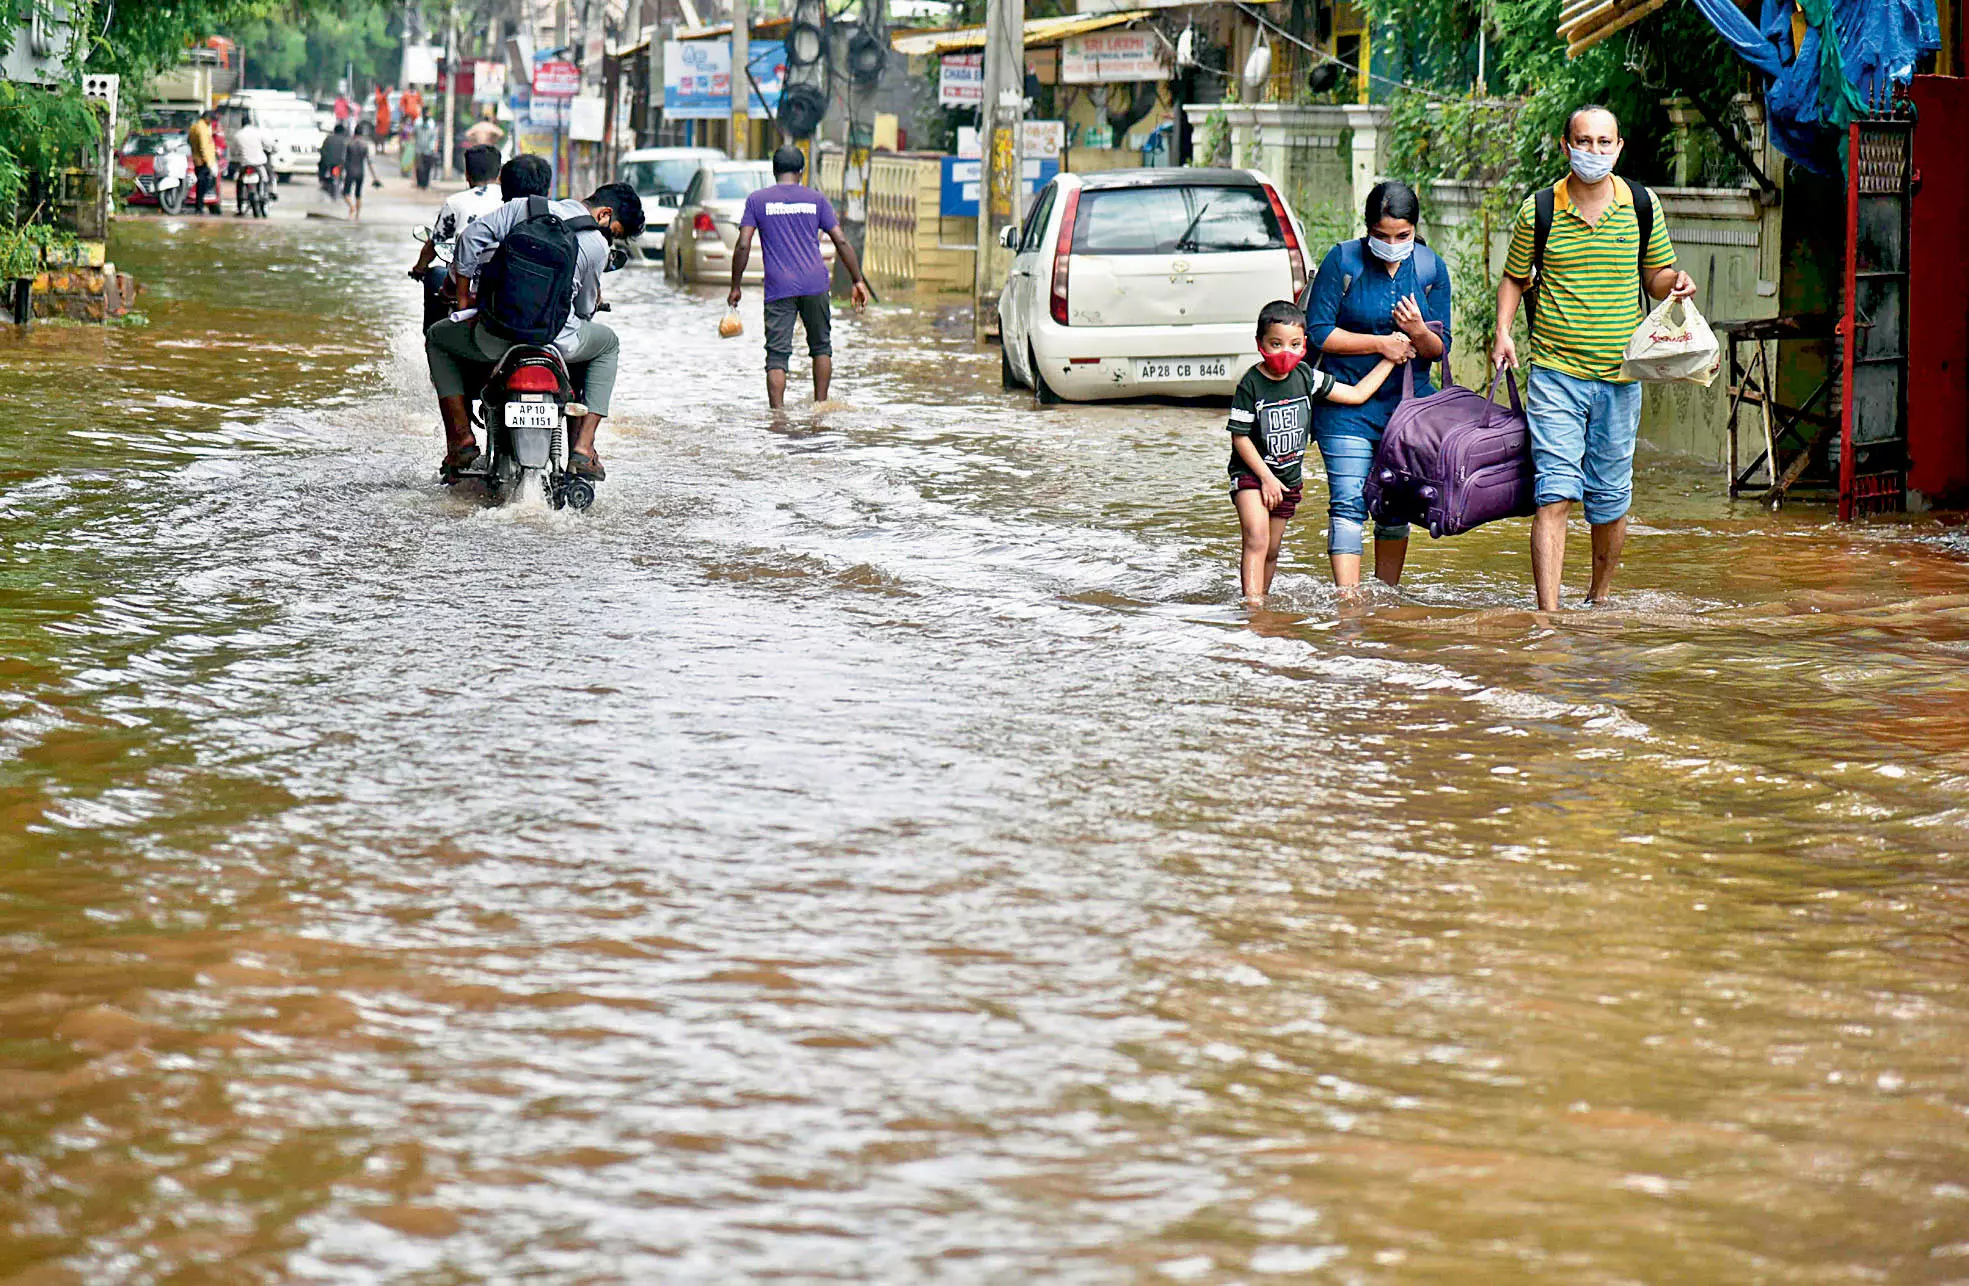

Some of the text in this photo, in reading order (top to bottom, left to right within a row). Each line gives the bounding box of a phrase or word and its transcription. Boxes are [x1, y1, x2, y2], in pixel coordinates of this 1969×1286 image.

[1177, 364, 1191, 377] CB
[1200, 364, 1225, 377] 8446
[512, 416, 551, 426] AN 1151
[1269, 405, 1299, 432] DET
[1267, 428, 1304, 456] ROIT
